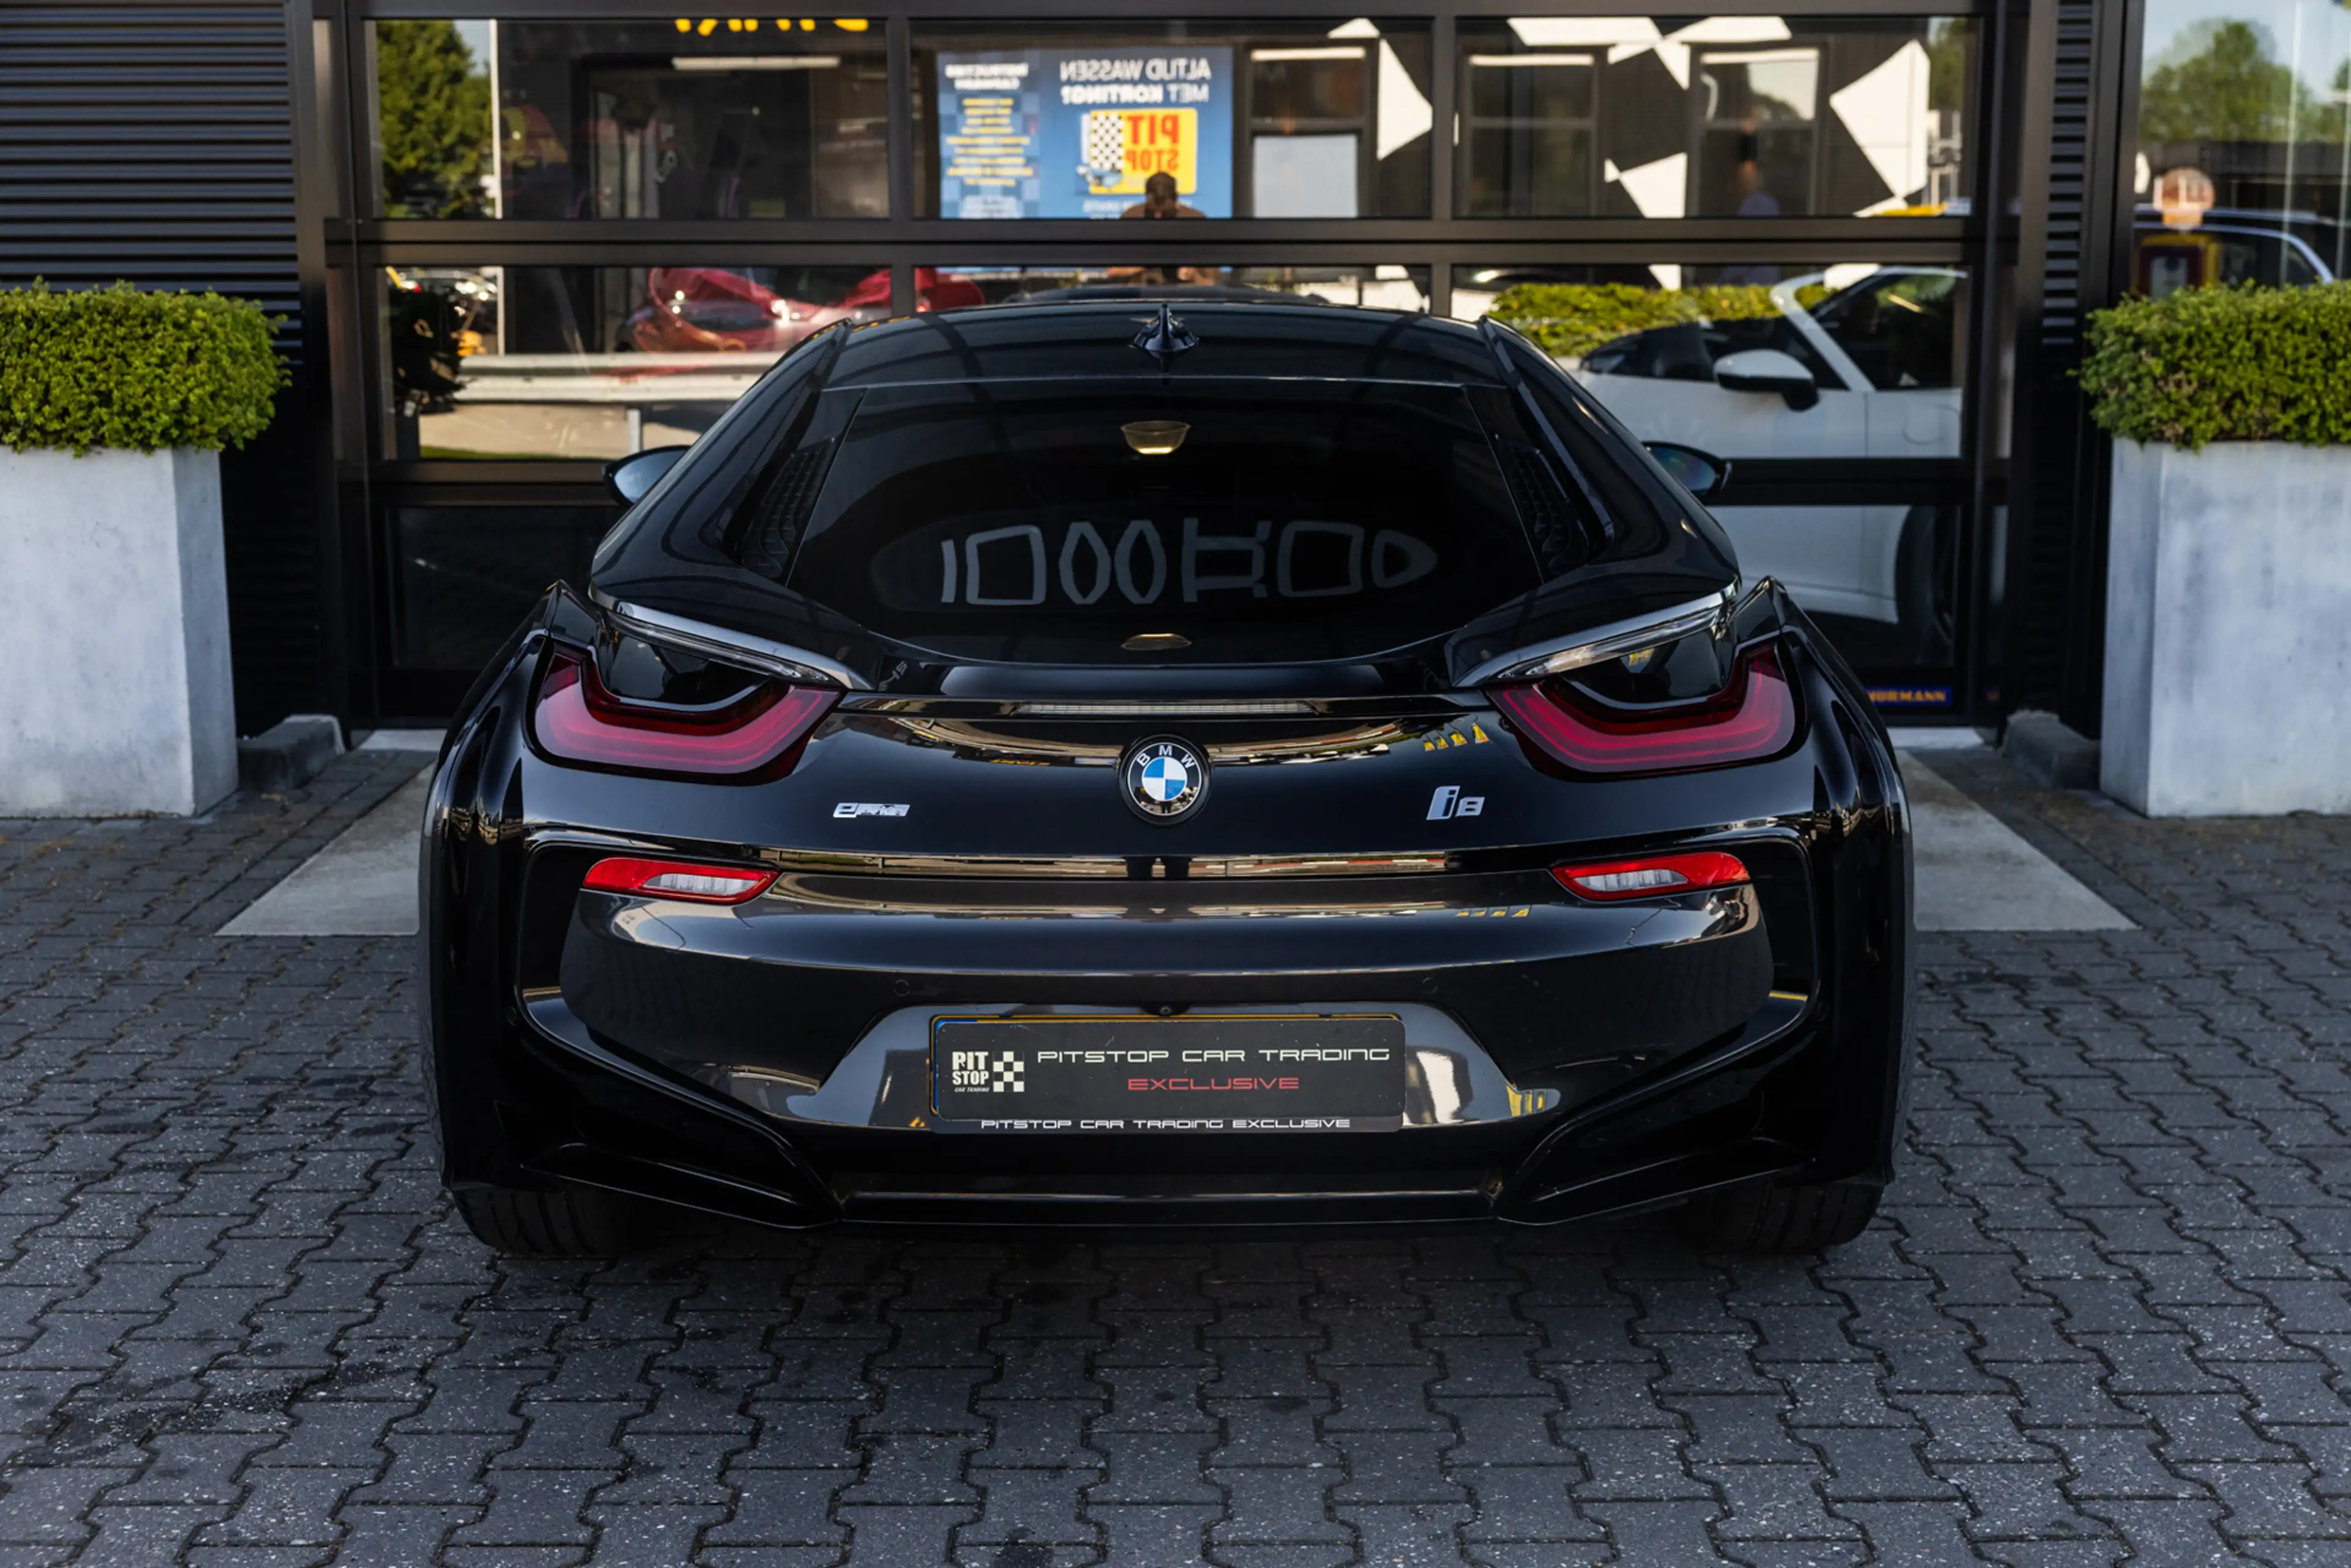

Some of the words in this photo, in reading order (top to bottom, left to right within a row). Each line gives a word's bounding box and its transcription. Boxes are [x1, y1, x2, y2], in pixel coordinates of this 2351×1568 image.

[1136, 745, 1196, 769] BMW
[1426, 786, 1486, 820] i8
[1038, 1051, 1169, 1063] PITSTOP
[1182, 1050, 1245, 1062] CAR
[1258, 1049, 1390, 1062] TRADING
[952, 1071, 989, 1085] STOP
[1128, 1078, 1299, 1090] EXCLUSIVE
[981, 1120, 1071, 1129] PITSTOP
[1080, 1120, 1124, 1129] CAR
[1133, 1120, 1223, 1129] TRADING
[1232, 1119, 1350, 1128] EXCLUSIVE
